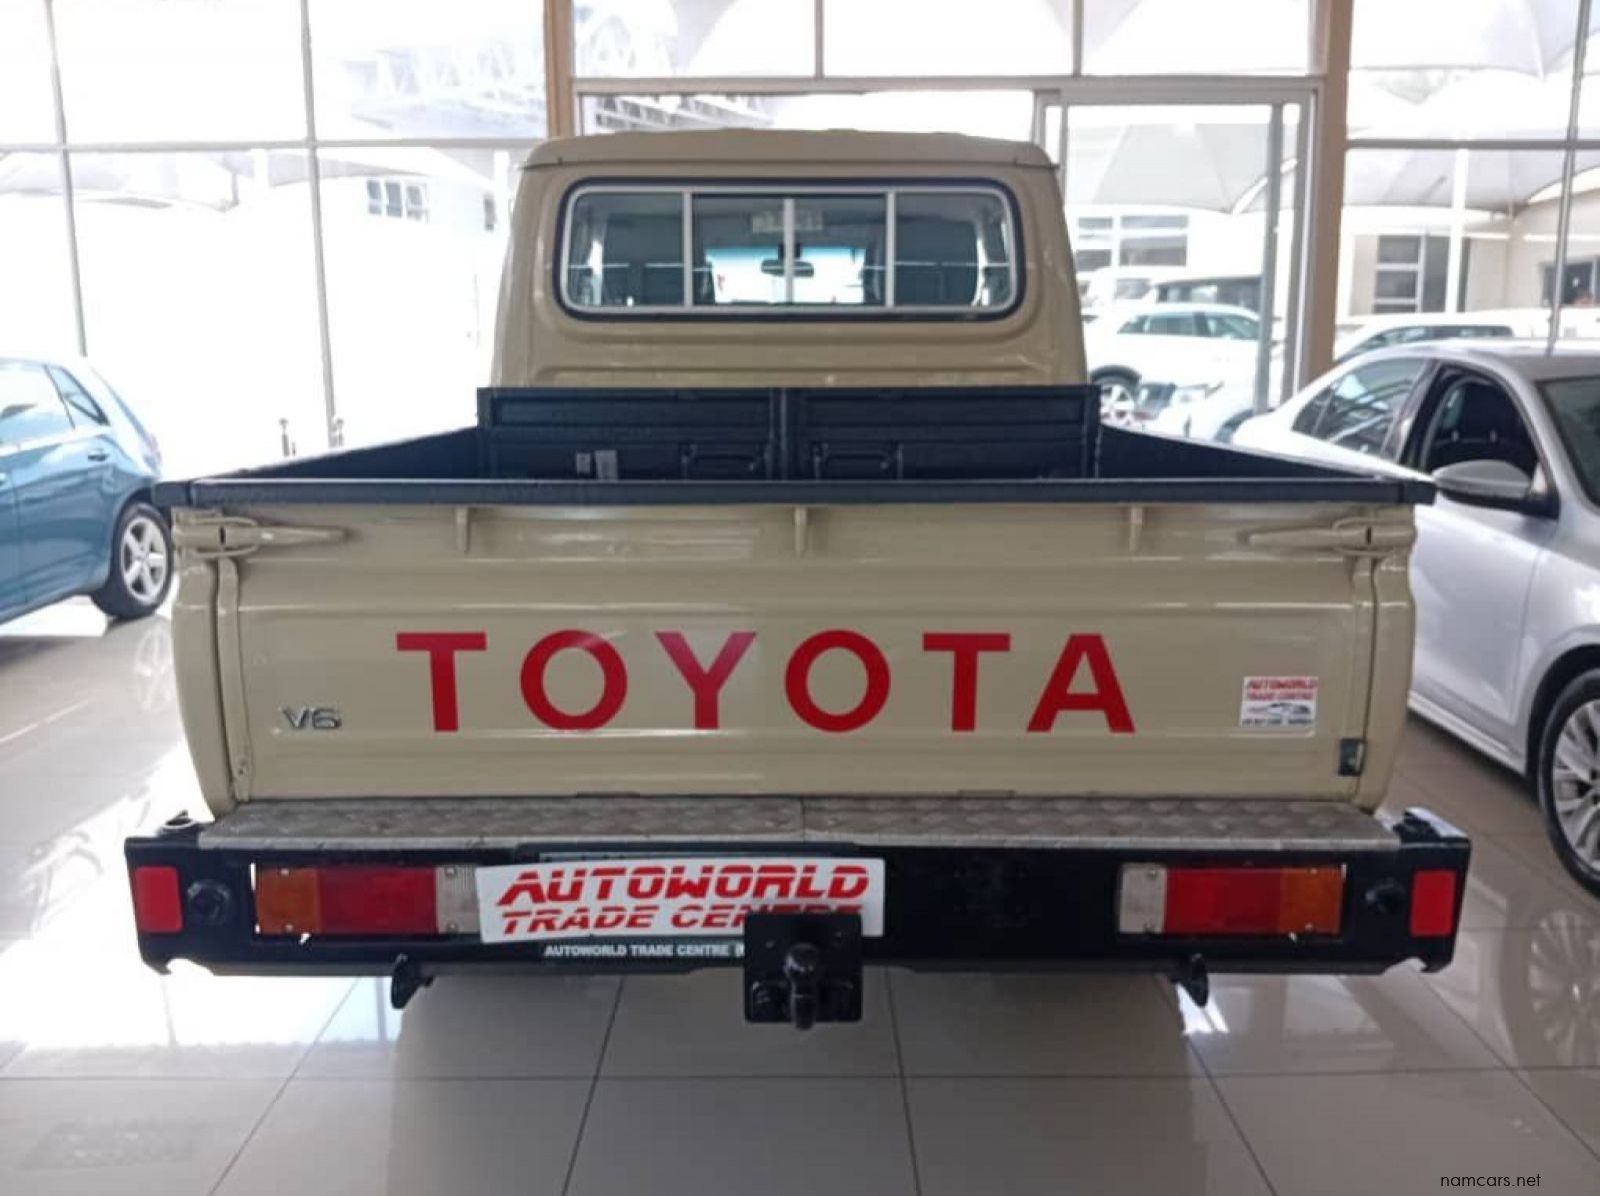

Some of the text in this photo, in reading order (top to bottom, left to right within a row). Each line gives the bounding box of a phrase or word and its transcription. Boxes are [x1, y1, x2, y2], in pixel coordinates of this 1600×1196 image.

[396, 629, 1135, 732] TOYOTA
[281, 706, 342, 729] V6
[496, 864, 869, 906] AUTOWORLD
[503, 905, 658, 934] TRADE
[544, 944, 627, 957] AUTOWORLD
[629, 944, 674, 957] TRADE
[677, 944, 729, 957] CENTRE
